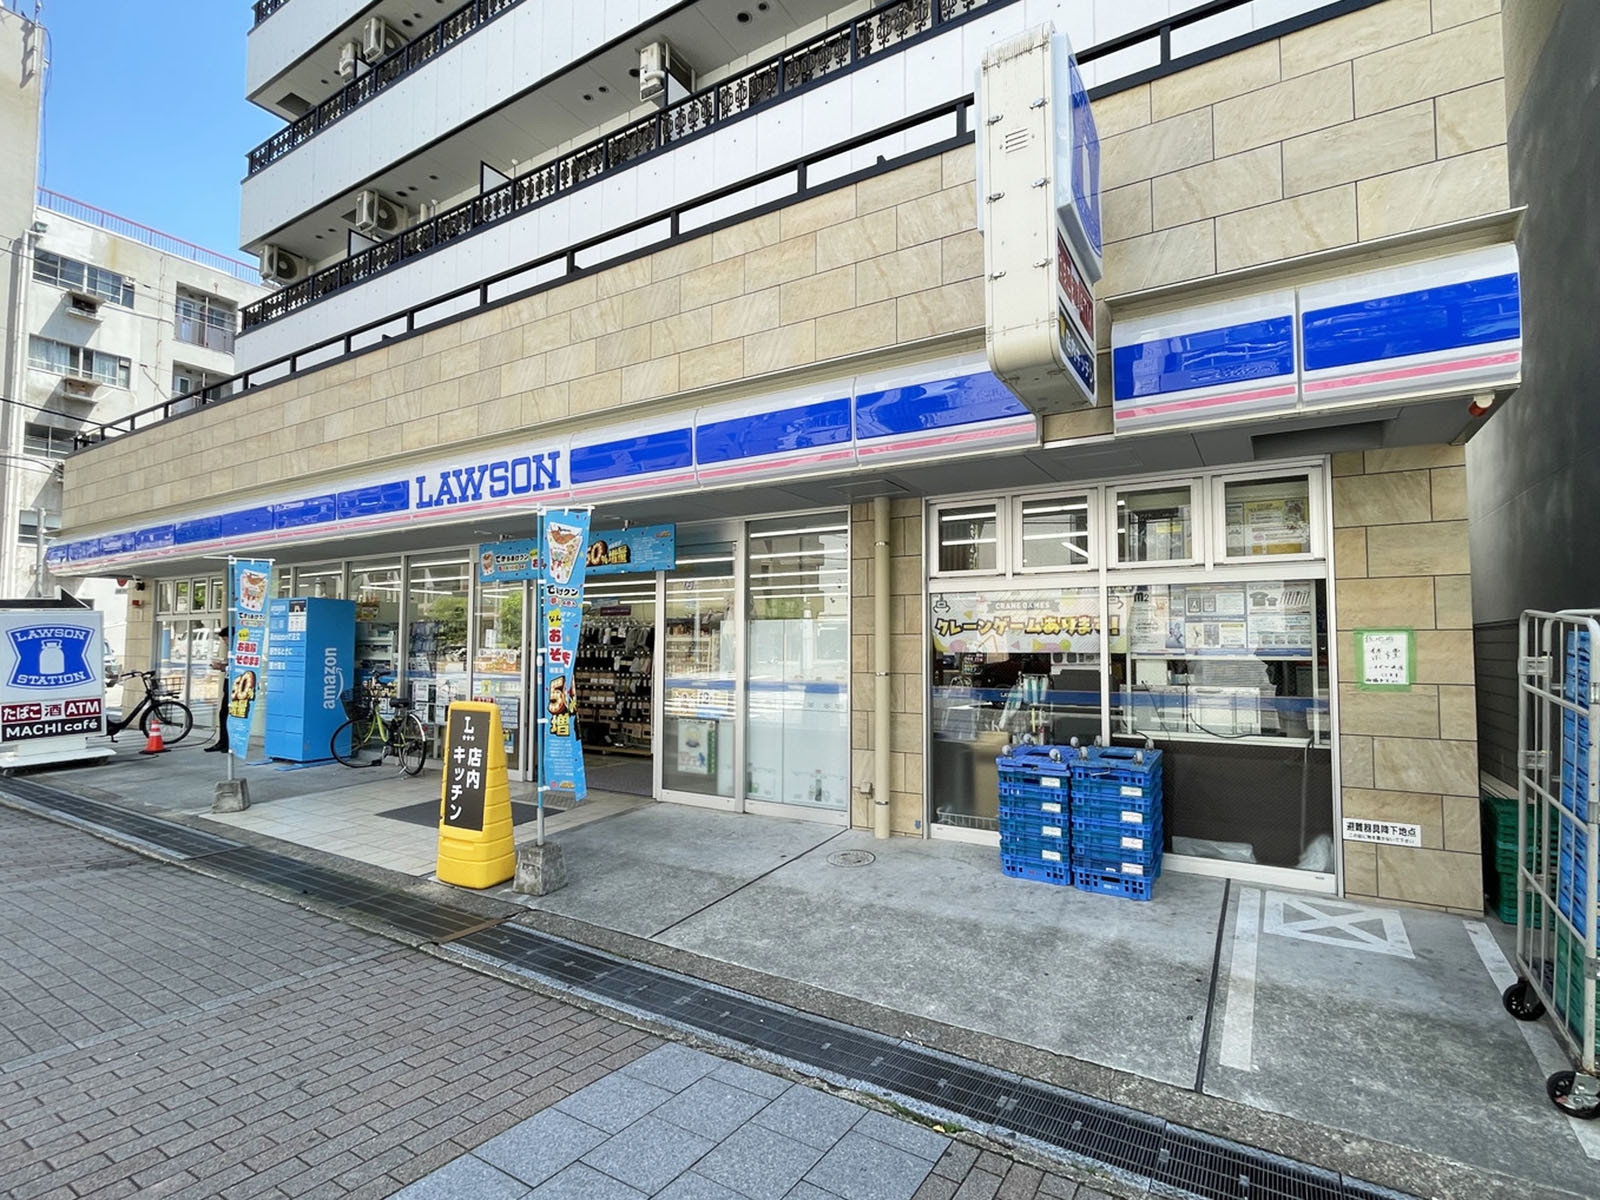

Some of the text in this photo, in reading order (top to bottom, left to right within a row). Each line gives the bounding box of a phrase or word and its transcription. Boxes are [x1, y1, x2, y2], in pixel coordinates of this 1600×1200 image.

[416, 451, 560, 509] LAWSON
[15, 629, 86, 641] LAWSON
[17, 671, 86, 685] STATION
[323, 648, 337, 709] amazon
[3, 705, 41, 720] たばこ
[66, 701, 100, 715] ATM
[6, 719, 98, 738] MACHI café
[449, 745, 466, 820] キッチン
[466, 747, 482, 789] 店内
